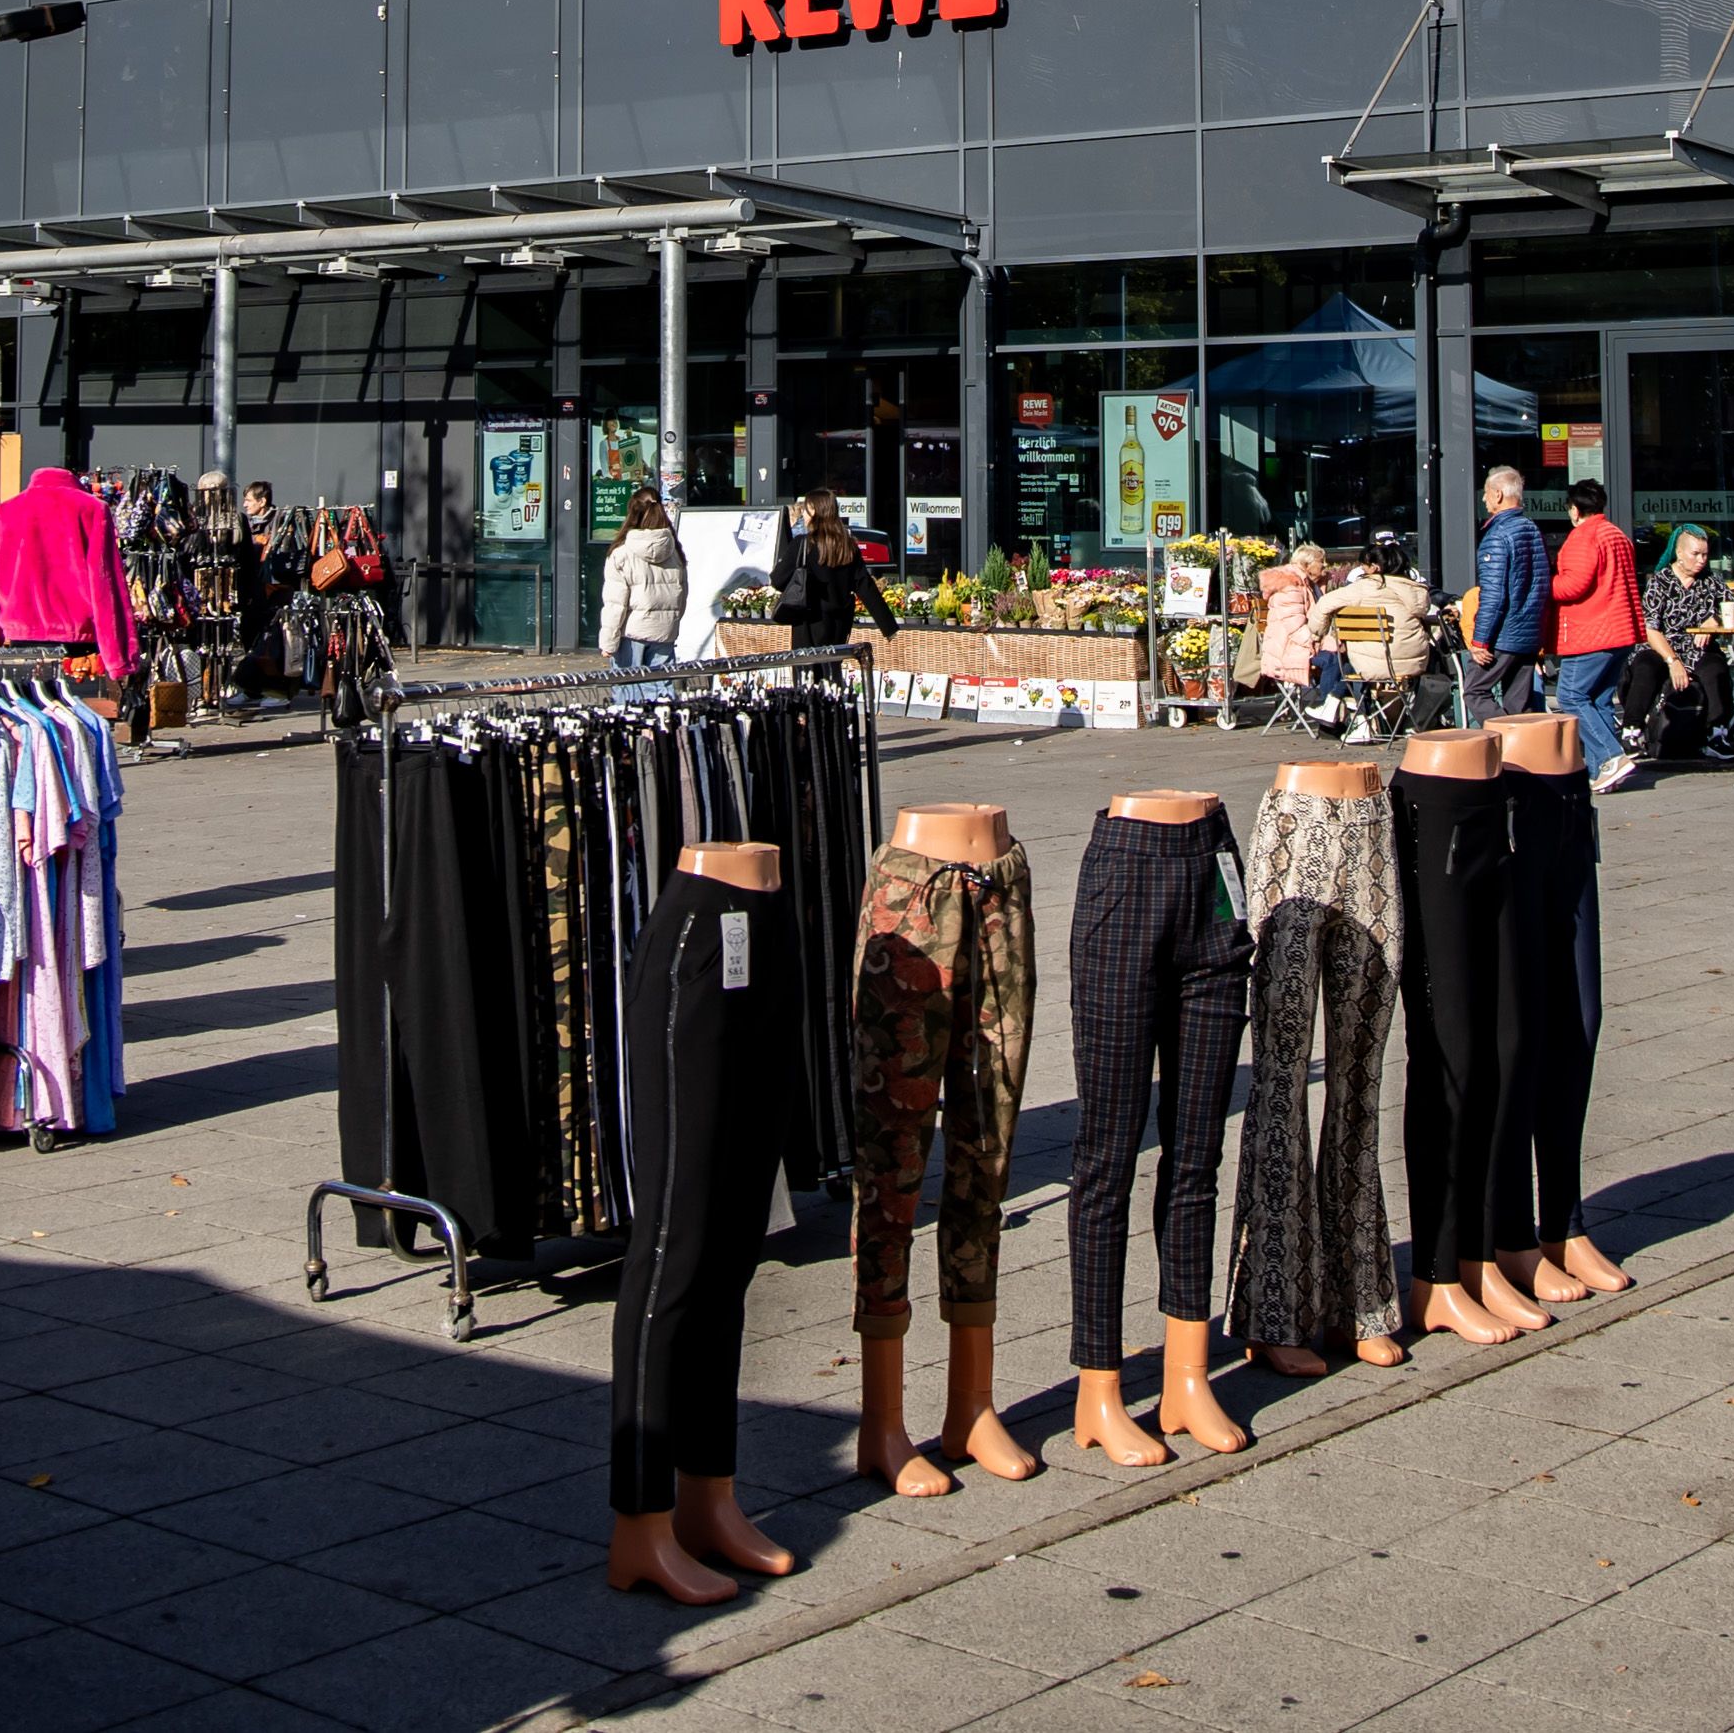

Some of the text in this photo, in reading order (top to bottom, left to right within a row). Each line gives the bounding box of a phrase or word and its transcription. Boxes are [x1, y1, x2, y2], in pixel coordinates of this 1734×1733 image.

[1023, 399, 1048, 409] REWE
[1018, 436, 1057, 449] Herzlich
[1018, 450, 1076, 463] willkommen
[910, 502, 961, 514] Willkommen
[1157, 503, 1180, 512] Knaller
[1530, 497, 1568, 513] Mark
[1641, 497, 1669, 514] deli
[1678, 497, 1724, 514] Markt
